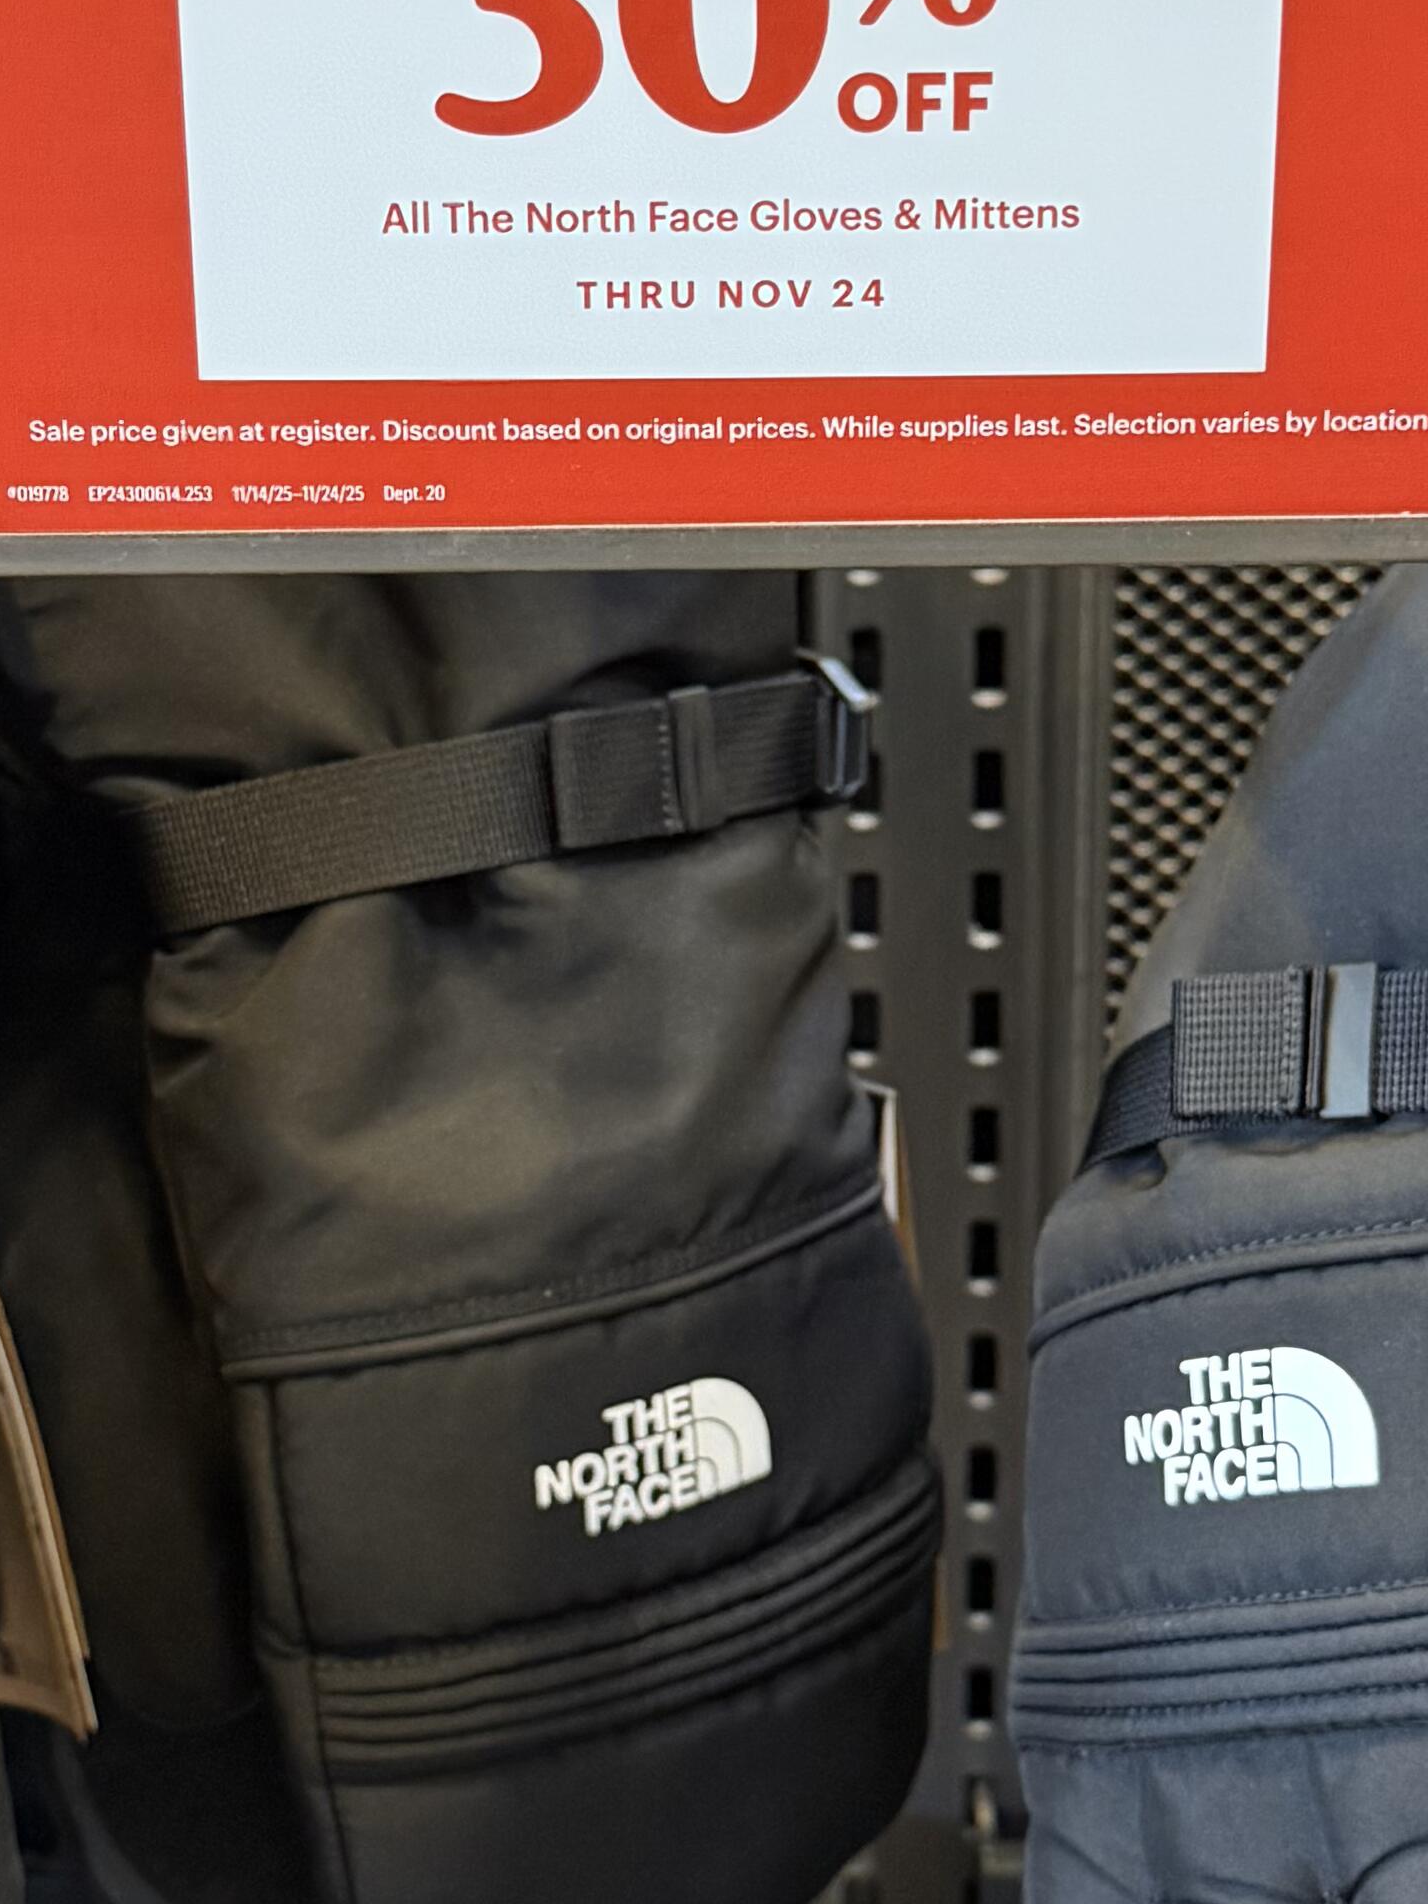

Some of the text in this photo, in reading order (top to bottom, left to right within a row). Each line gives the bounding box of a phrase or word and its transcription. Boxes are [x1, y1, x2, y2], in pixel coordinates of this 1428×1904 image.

[836, 70, 996, 136] OFF
[381, 195, 1081, 236] All The North Face Gloves & Mittens
[576, 278, 887, 311] THRU NOV 24
[28, 418, 85, 443] Sale
[90, 420, 157, 447] price
[162, 419, 234, 447] given
[239, 421, 265, 443] at
[270, 419, 377, 447] register.
[383, 417, 496, 442] Discount
[503, 417, 579, 442] based
[587, 422, 620, 442] on
[625, 416, 724, 445] original
[728, 417, 817, 443] prices.
[822, 415, 894, 440] While
[899, 414, 1009, 443] supplies
[1013, 413, 1068, 438] last.
[1073, 412, 1197, 437] Selection
[1202, 412, 1281, 434] varies
[1285, 410, 1318, 437] by
[383, 484, 424, 504] Dept.
[424, 484, 447, 502] 20
[1179, 1348, 1274, 1406] THE
[601, 1383, 693, 1445] THE
[1123, 1395, 1277, 1466] NORTH
[533, 1422, 696, 1511] NORTH
[1163, 1443, 1278, 1507] FACE
[583, 1461, 699, 1537] FACE
